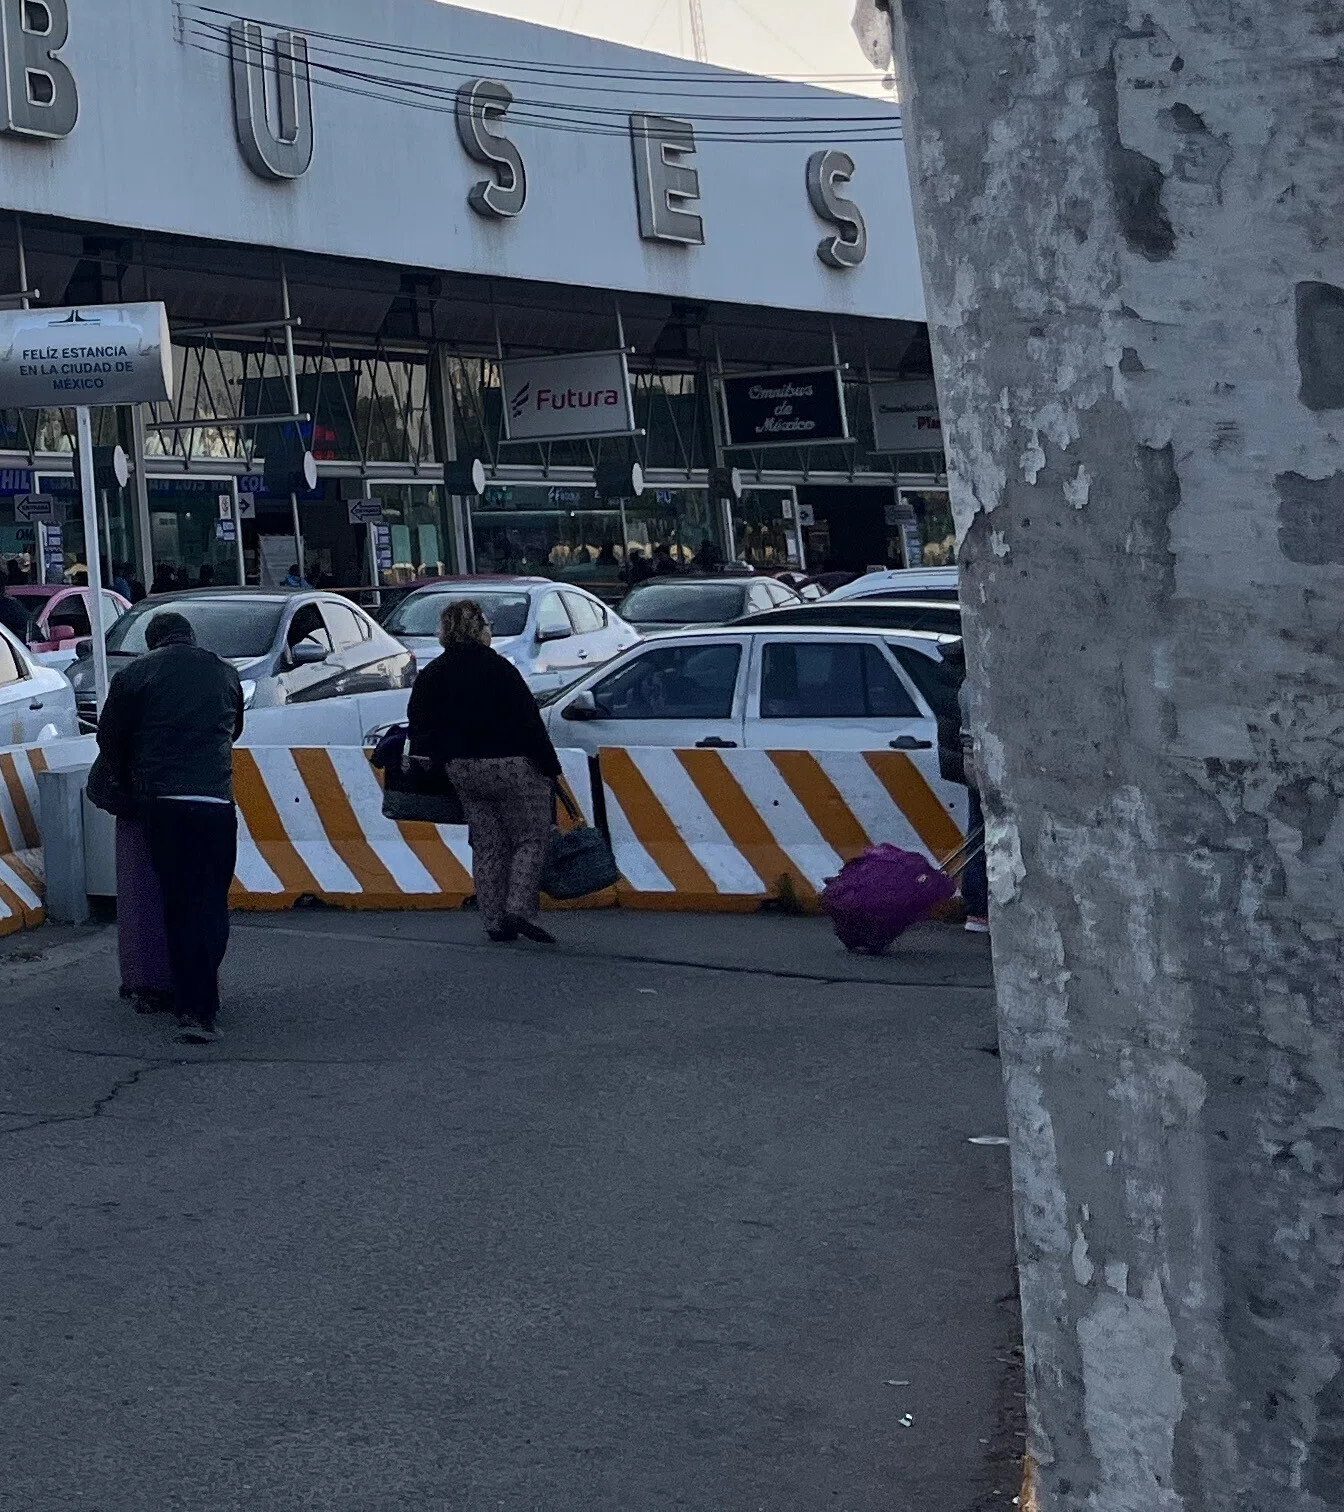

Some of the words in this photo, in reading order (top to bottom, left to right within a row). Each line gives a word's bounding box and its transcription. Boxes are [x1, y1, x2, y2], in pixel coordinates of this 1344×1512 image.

[22, 345, 58, 360] FELÍZ
[62, 345, 128, 359] ESTANCIA
[19, 365, 38, 376] EN
[40, 364, 59, 375] LA
[62, 362, 112, 374] CIUDAD
[115, 361, 134, 373] DE
[52, 377, 104, 390] MÉXICO
[748, 382, 814, 400] Omnibus
[536, 388, 619, 411] Futura
[773, 400, 793, 416] de
